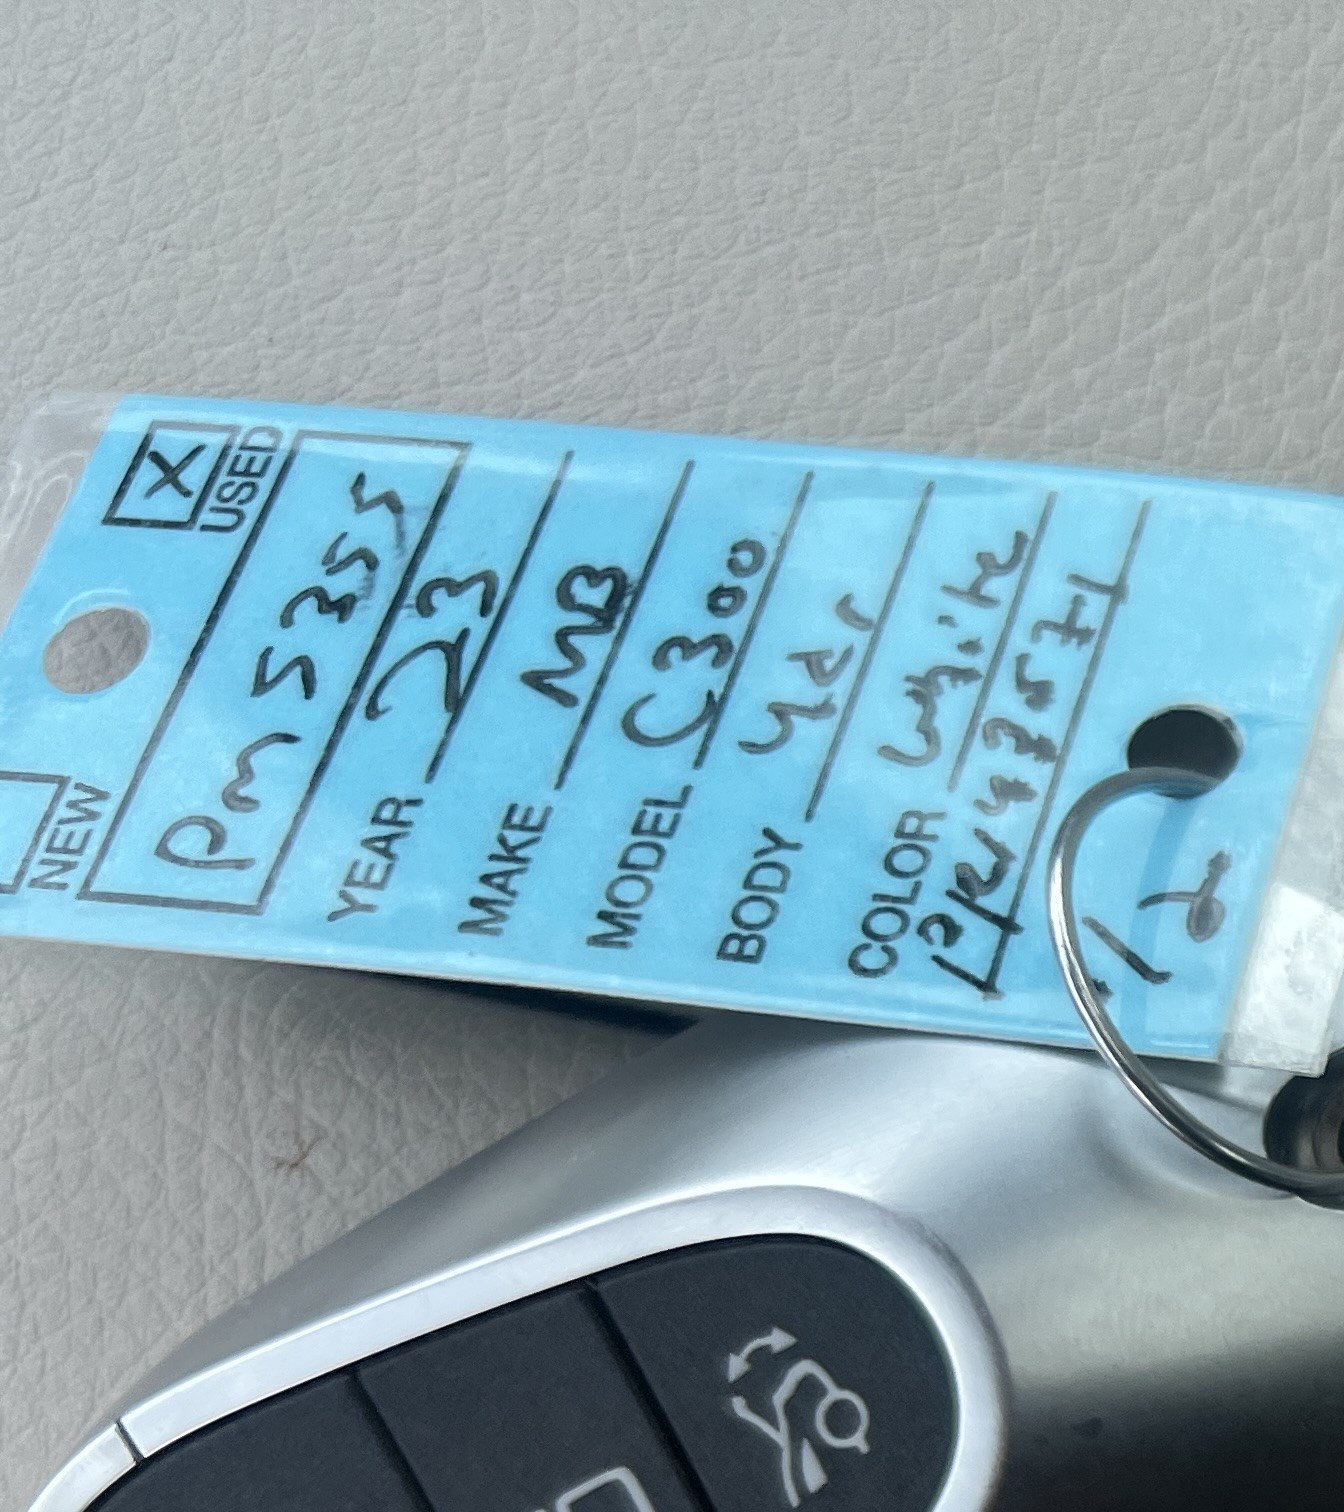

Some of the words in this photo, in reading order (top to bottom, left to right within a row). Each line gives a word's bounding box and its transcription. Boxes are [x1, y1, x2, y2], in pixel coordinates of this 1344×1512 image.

[200, 424, 281, 533] USED
[364, 569, 499, 721] 23
[622, 539, 766, 746] C300
[458, 804, 553, 935] MAKE
[522, 564, 630, 708] MB
[30, 783, 111, 891] NEW
[329, 797, 425, 921] YEAR
[587, 786, 693, 950] MODEL
[717, 827, 803, 964] BODY
[848, 809, 946, 979] COLOR
